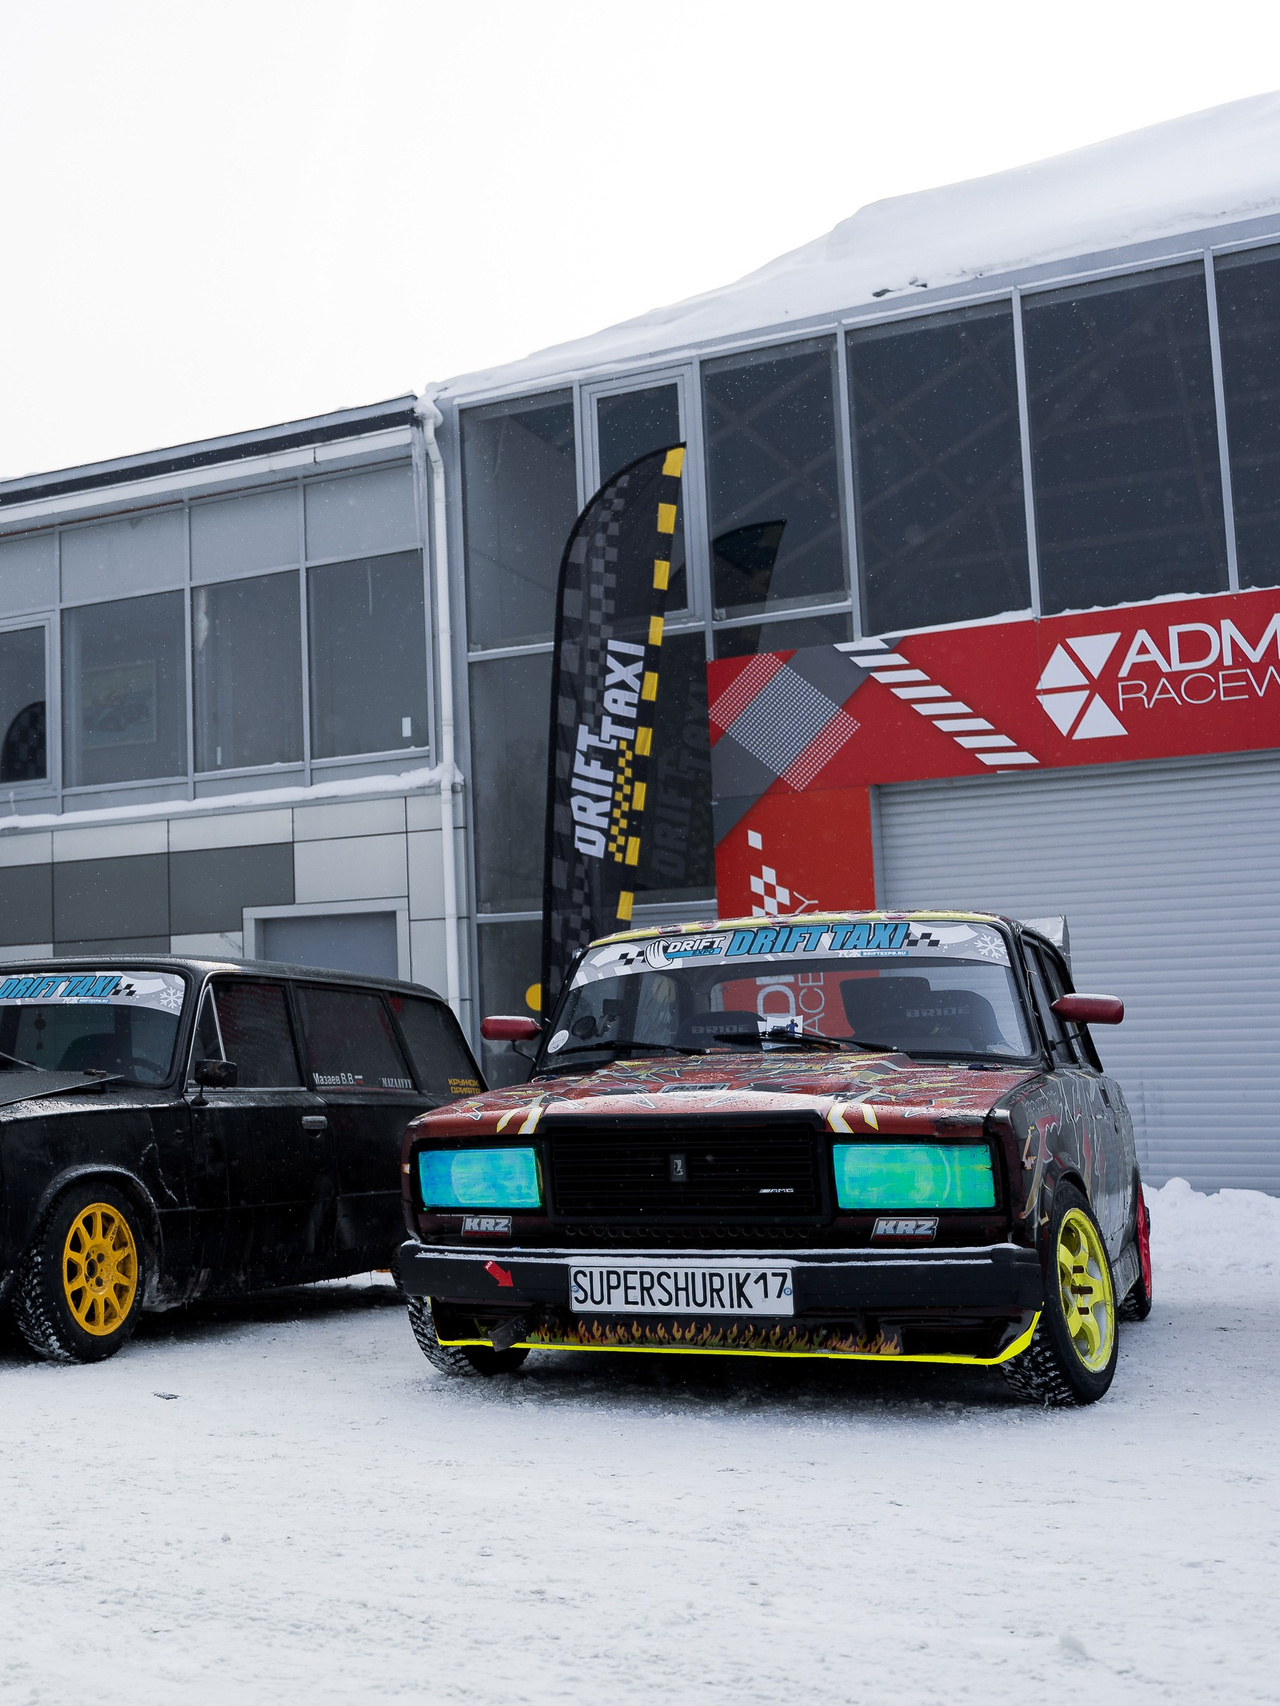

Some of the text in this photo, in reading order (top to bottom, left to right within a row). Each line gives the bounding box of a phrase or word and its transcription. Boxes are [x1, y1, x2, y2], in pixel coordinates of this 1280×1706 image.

[1118, 613, 1280, 678] ADM
[600, 639, 645, 740] TAXI
[570, 724, 617, 858] DRIFT
[667, 936, 726, 953] DRIFT
[725, 923, 910, 956] DRIFT TAXI
[60, 975, 123, 998] TAXI
[465, 1218, 509, 1231] KRZ
[876, 1219, 936, 1235] KRZ
